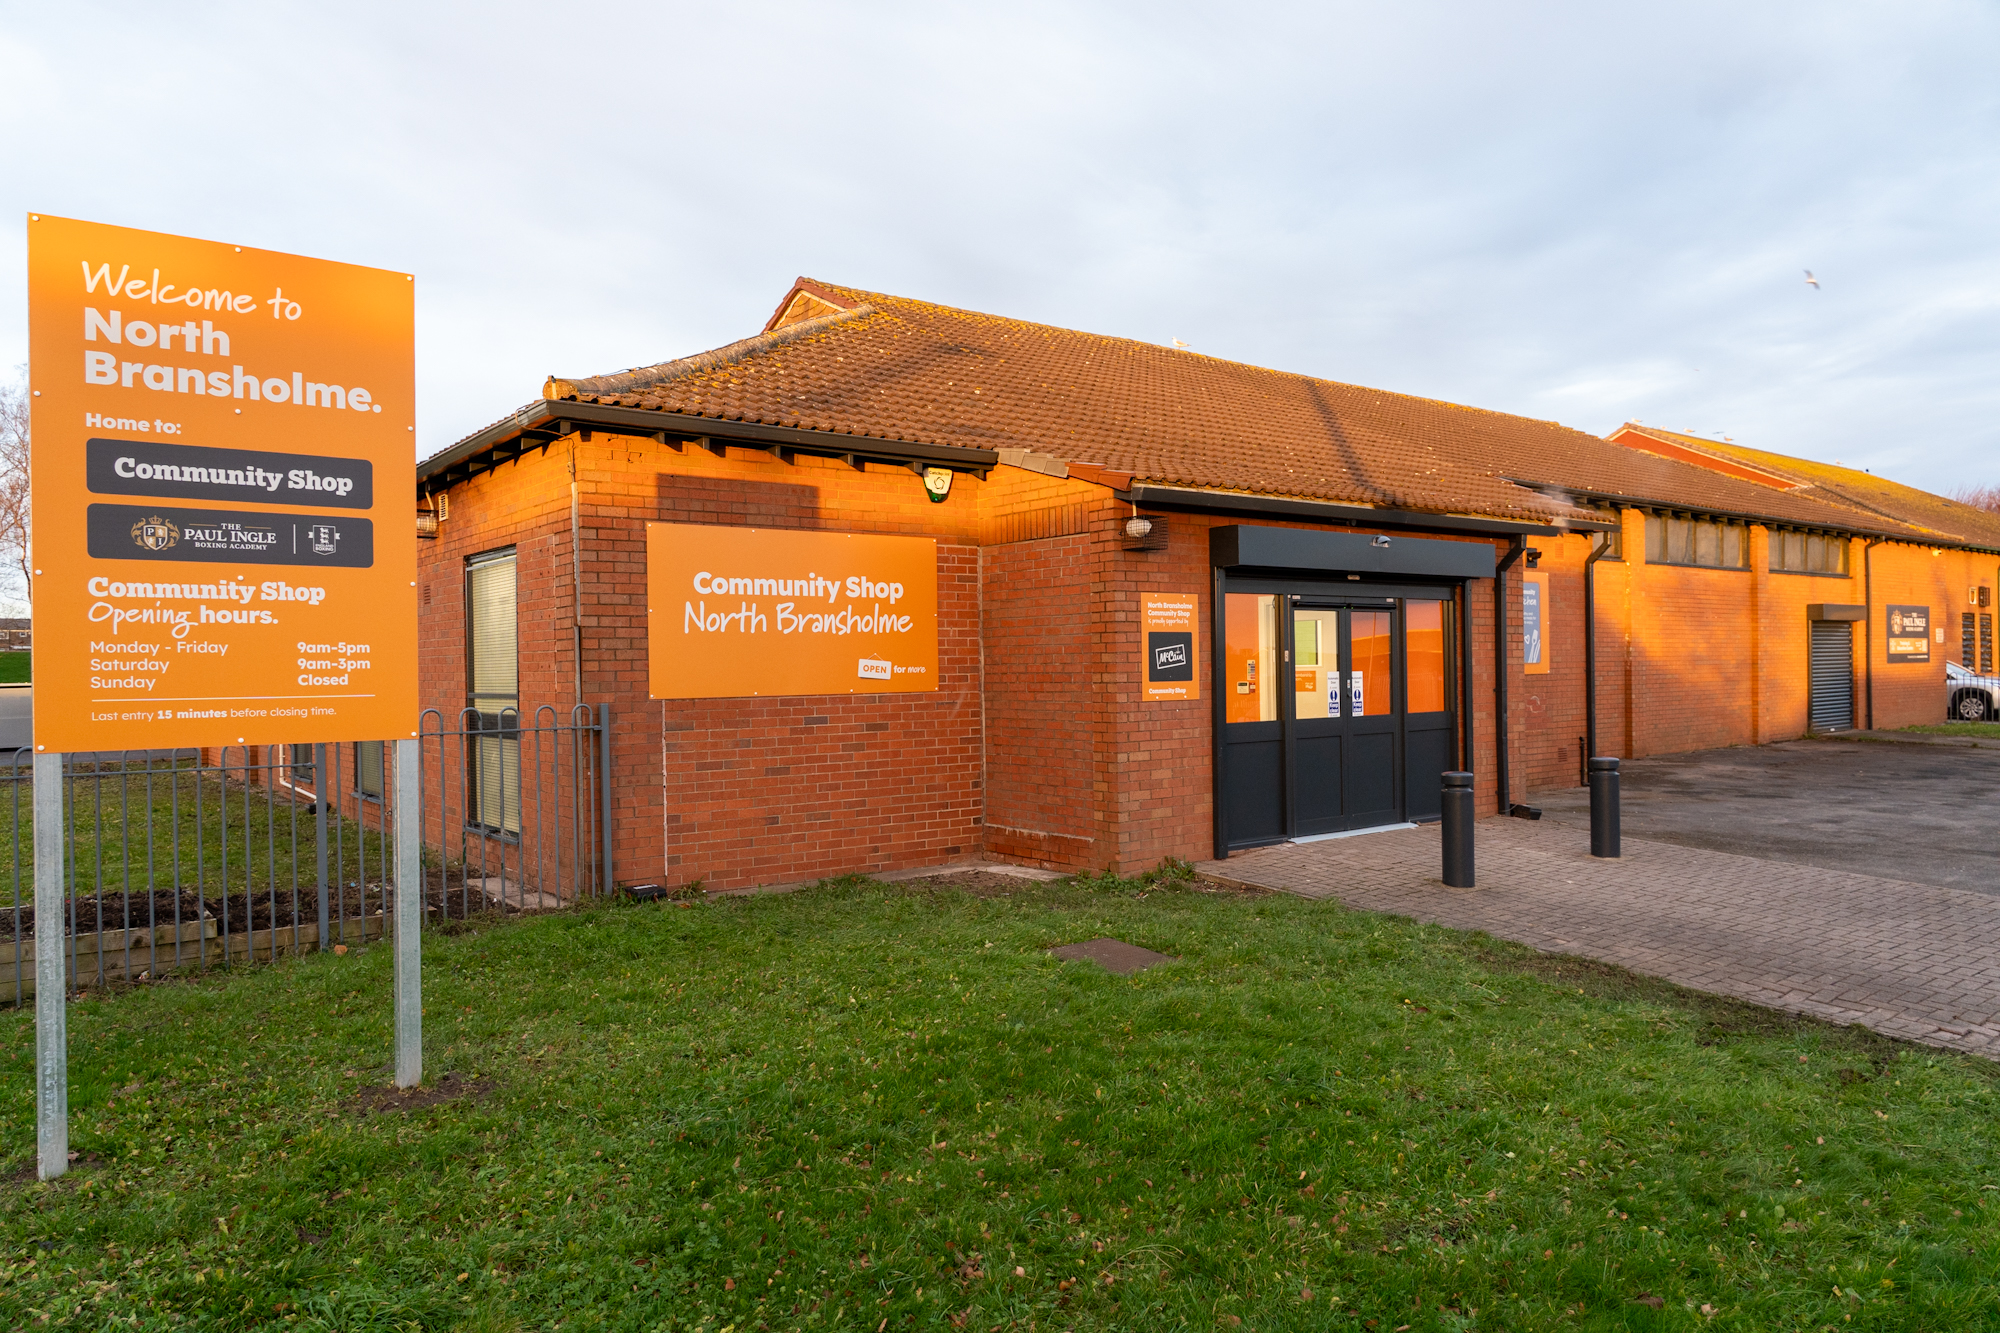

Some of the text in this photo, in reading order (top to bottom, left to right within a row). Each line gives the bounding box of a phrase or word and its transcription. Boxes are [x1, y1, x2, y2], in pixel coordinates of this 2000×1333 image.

[82, 261, 302, 320] Welcome to
[84, 307, 230, 356] North
[84, 350, 382, 413] Bransholme.
[86, 412, 182, 435] Home to:
[114, 456, 353, 496] Community Shop
[221, 523, 242, 531] THE
[184, 528, 276, 544] PAUL INGLE
[194, 541, 267, 551] BOXING ACADEMY
[88, 576, 326, 605] Community Shop
[693, 571, 904, 604] Community Shop
[88, 601, 278, 639] Opening hours.
[684, 600, 913, 635] North Bransholme
[1147, 609, 1190, 618] Community Shop
[90, 641, 160, 656] Monday
[177, 641, 228, 656] Friday
[297, 641, 371, 656] 9am-5pm
[297, 658, 371, 671] 9am-3pm
[1159, 651, 1184, 664] McCain
[90, 658, 170, 673] Saturday
[862, 664, 926, 674] OPEN for more
[90, 676, 156, 691] Sunday
[297, 674, 349, 686] Closed
[91, 705, 337, 722] Last entry 15 minutes before closing time.
